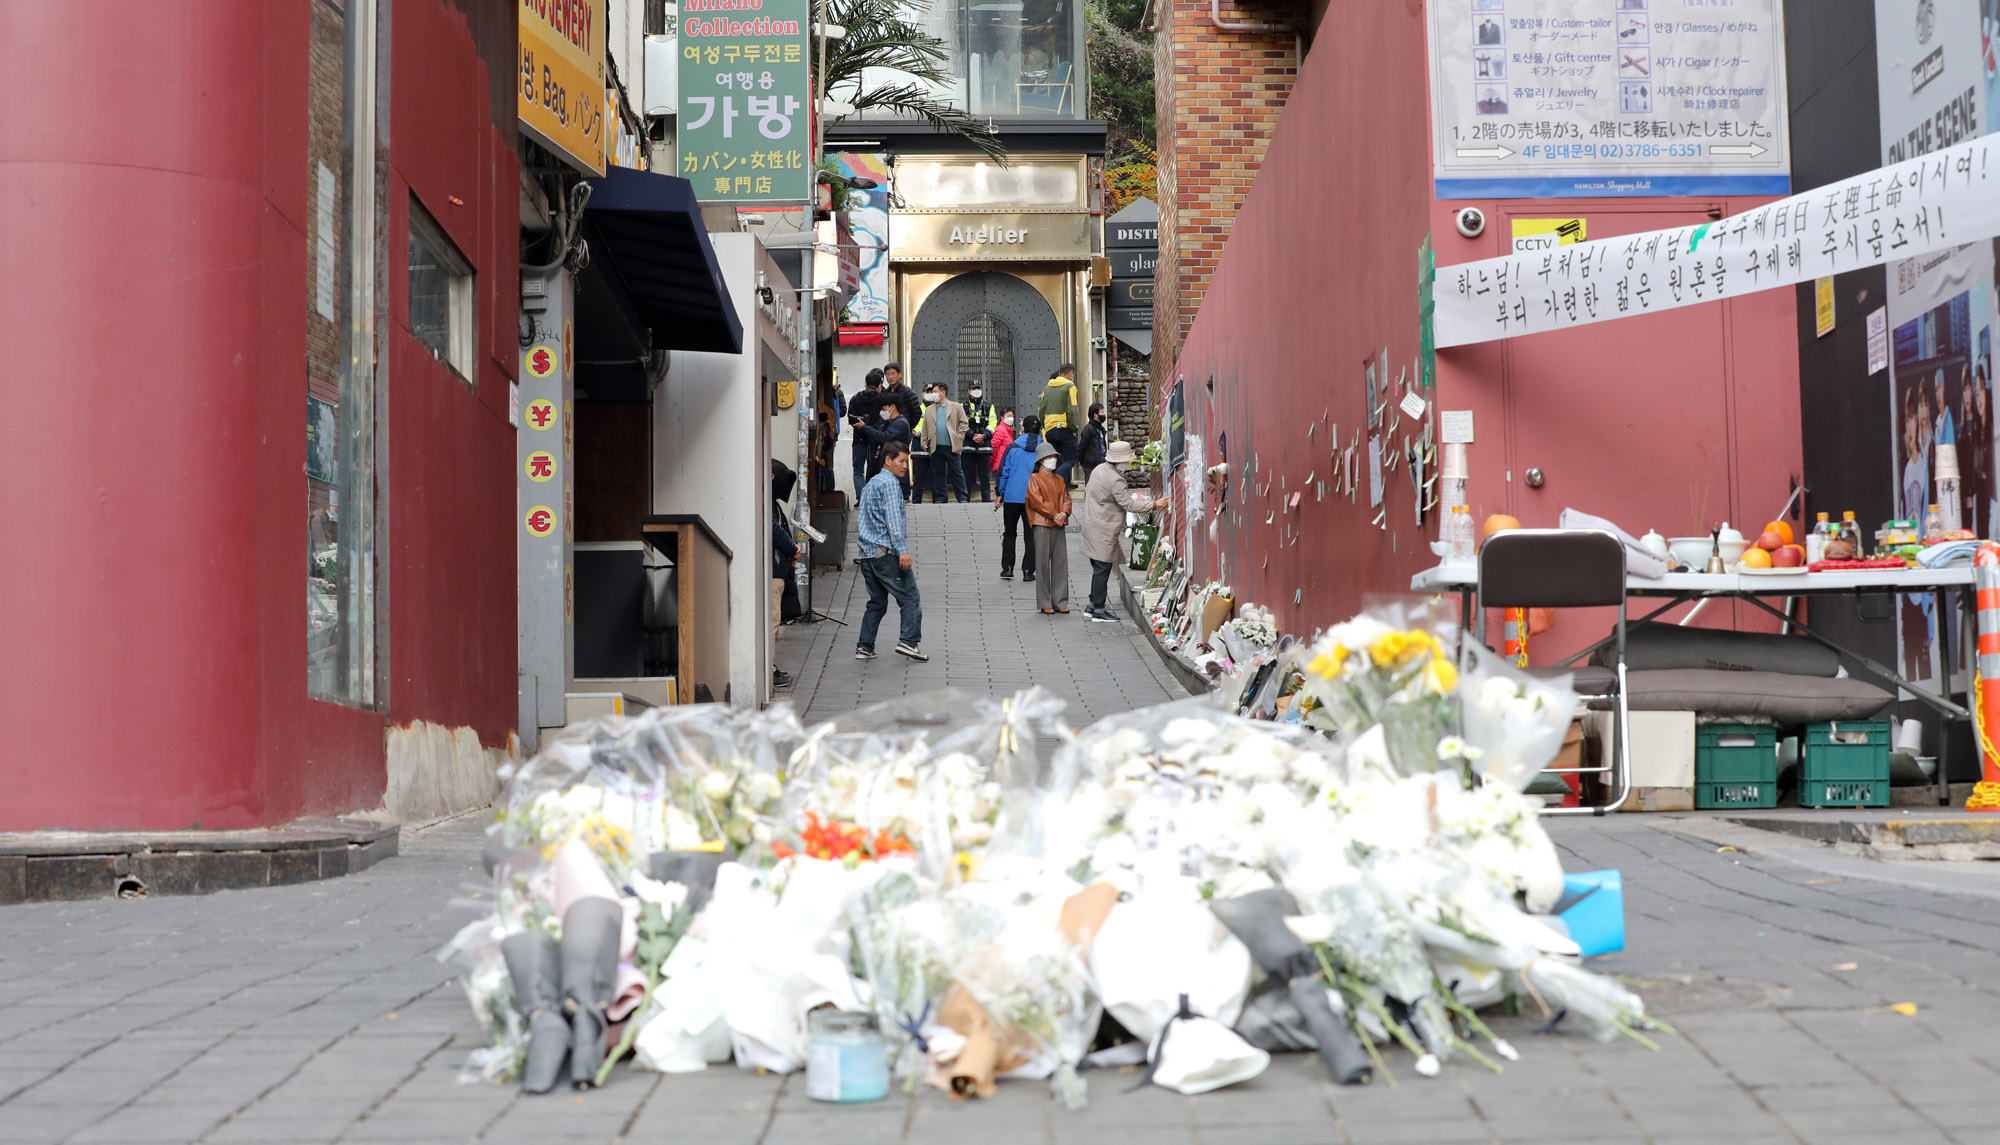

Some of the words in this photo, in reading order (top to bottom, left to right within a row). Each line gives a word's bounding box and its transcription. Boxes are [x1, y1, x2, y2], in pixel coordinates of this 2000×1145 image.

[684, 16, 800, 37] Collection
[1551, 18, 1612, 28] Custom-tailor
[1654, 22, 1673, 33] 안경
[1681, 22, 1719, 32] Glasses
[1726, 22, 1758, 33] めがね
[1529, 31, 1599, 42] オーダーメード
[683, 43, 802, 66] 여성구두전문
[1511, 53, 1545, 64] 토산품
[1554, 53, 1575, 63] Gift
[1576, 53, 1613, 63] center
[1656, 57, 1676, 68] 시가
[1684, 57, 1712, 69] Cigar
[1721, 57, 1751, 67] シガー
[1530, 65, 1595, 77] ギフトショップ
[715, 71, 776, 91] 여행용
[1513, 87, 1546, 99] 쥬얼리
[1556, 87, 1599, 99] Jewelry
[1657, 85, 1675, 97] 시계
[1676, 85, 1694, 96] 수리
[1702, 85, 1728, 96] Clock
[1728, 86, 1765, 98] repairer
[1535, 101, 1585, 111] ジュエリー
[1684, 98, 1740, 110] 時計修理店
[686, 95, 801, 140] 가방
[1907, 117, 1931, 159] THE
[1935, 85, 1977, 151] SCENE
[1471, 121, 1585, 141] 2階の売場が3,
[1589, 120, 1773, 139] 4階に移転いたしました。
[1522, 144, 1541, 158] 4F
[1543, 144, 1597, 160] 임대문의
[1600, 143, 1703, 159] 02)3786-6351
[683, 150, 803, 174] カバン・女性化
[1607, 180, 1635, 192] Shopping
[1636, 180, 1653, 190] Mall
[948, 225, 1029, 245] Atelier
[1515, 239, 1553, 251] CCTV
[1458, 261, 1521, 301] 하느님!
[1538, 245, 1607, 285] 부처님!
[1622, 229, 1697, 271] 상제님!
[1495, 295, 1528, 332] 부디
[1544, 281, 1600, 323] 가련한
[1615, 272, 1652, 312] 젊은
[1668, 256, 1727, 303] 원혼을
[1744, 237, 1801, 285] 구제해
[1821, 204, 1947, 268] 주시옵소서!
[531, 456, 551, 477] 元
